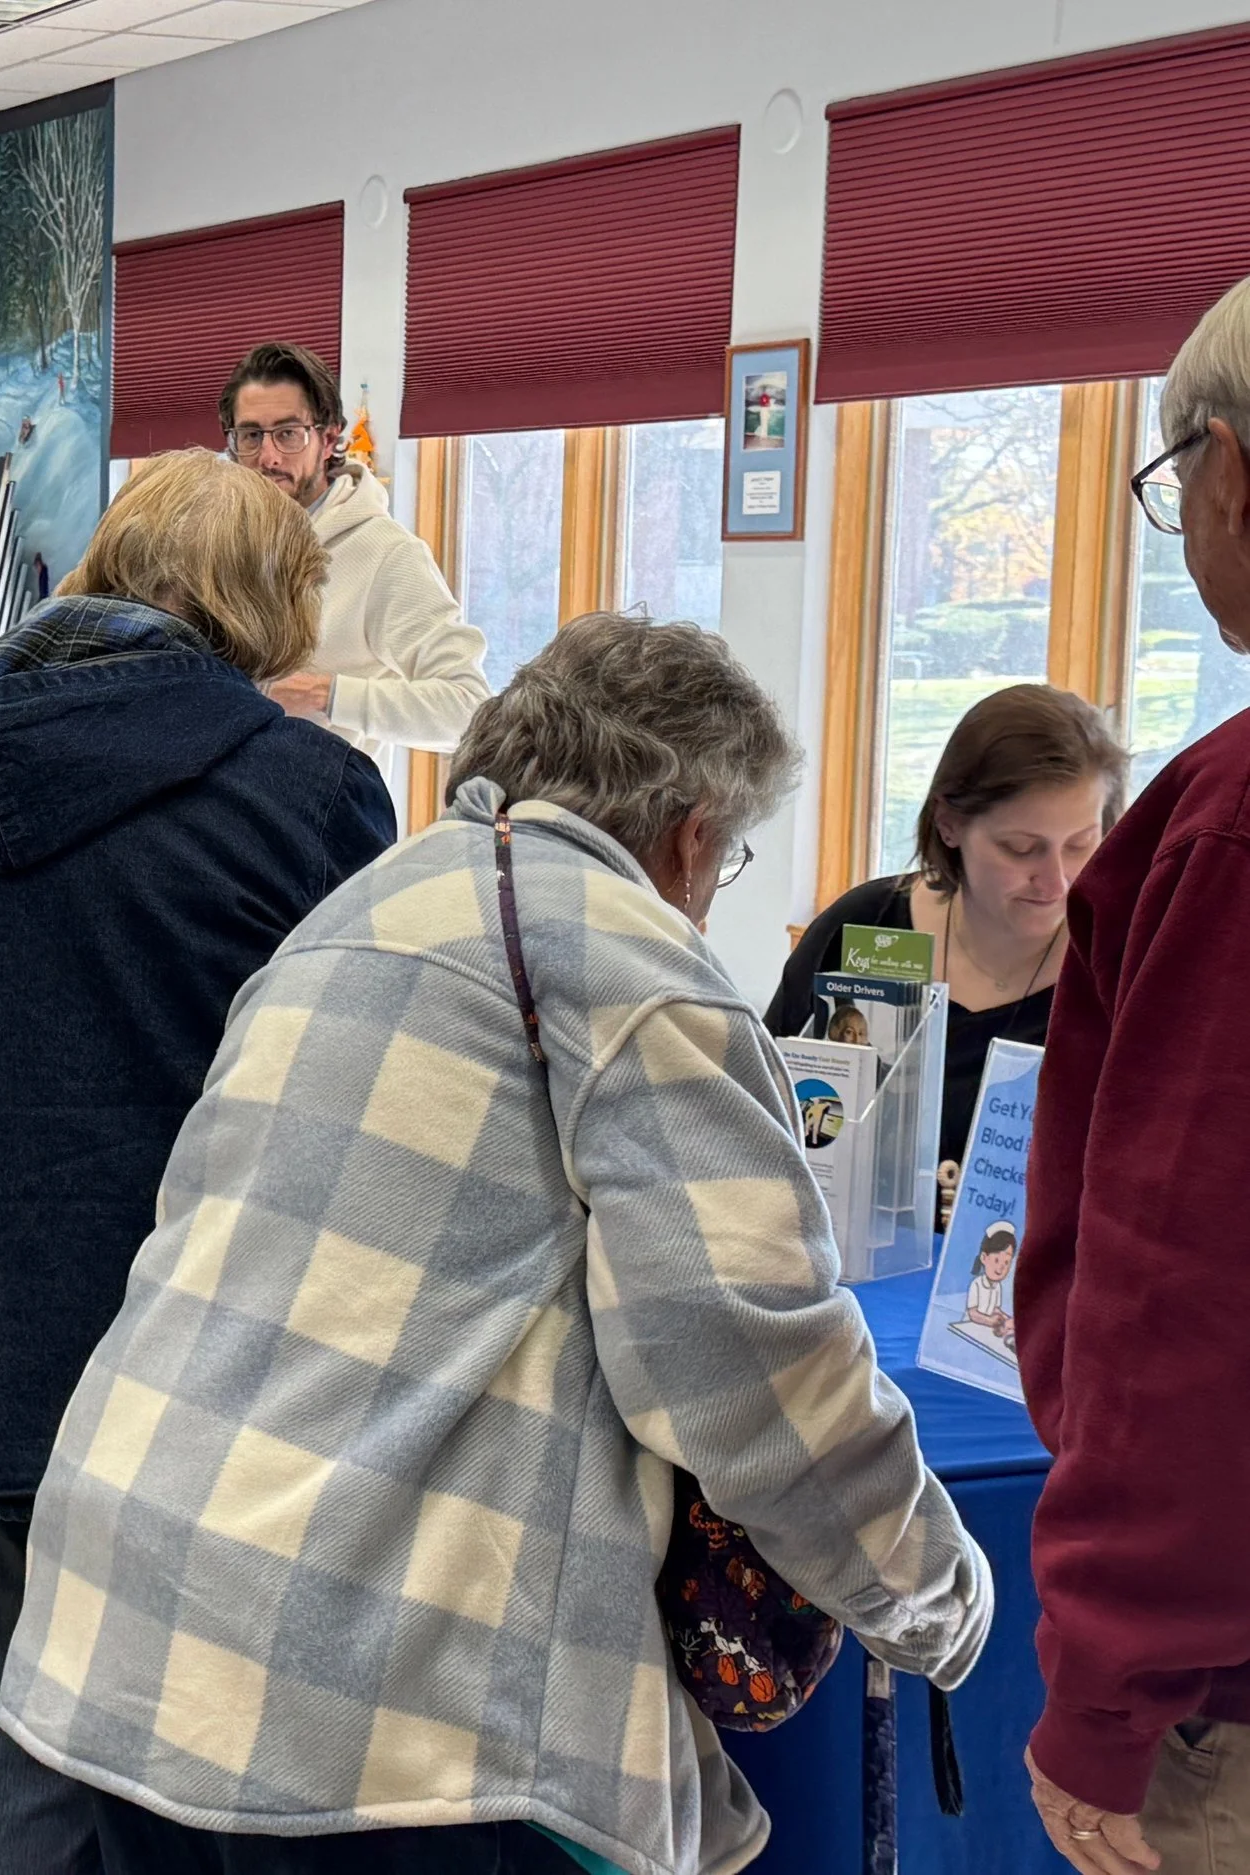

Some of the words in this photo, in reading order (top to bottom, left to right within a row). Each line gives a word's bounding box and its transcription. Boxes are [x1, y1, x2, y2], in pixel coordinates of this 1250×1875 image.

[845, 947, 870, 973] Keys
[826, 981, 852, 993] Older
[853, 984, 885, 997] Drivers
[989, 1097, 1018, 1119] Get
[981, 1126, 1025, 1153] Blood
[973, 1157, 1026, 1187] Checke
[967, 1186, 1017, 1219] Today!
